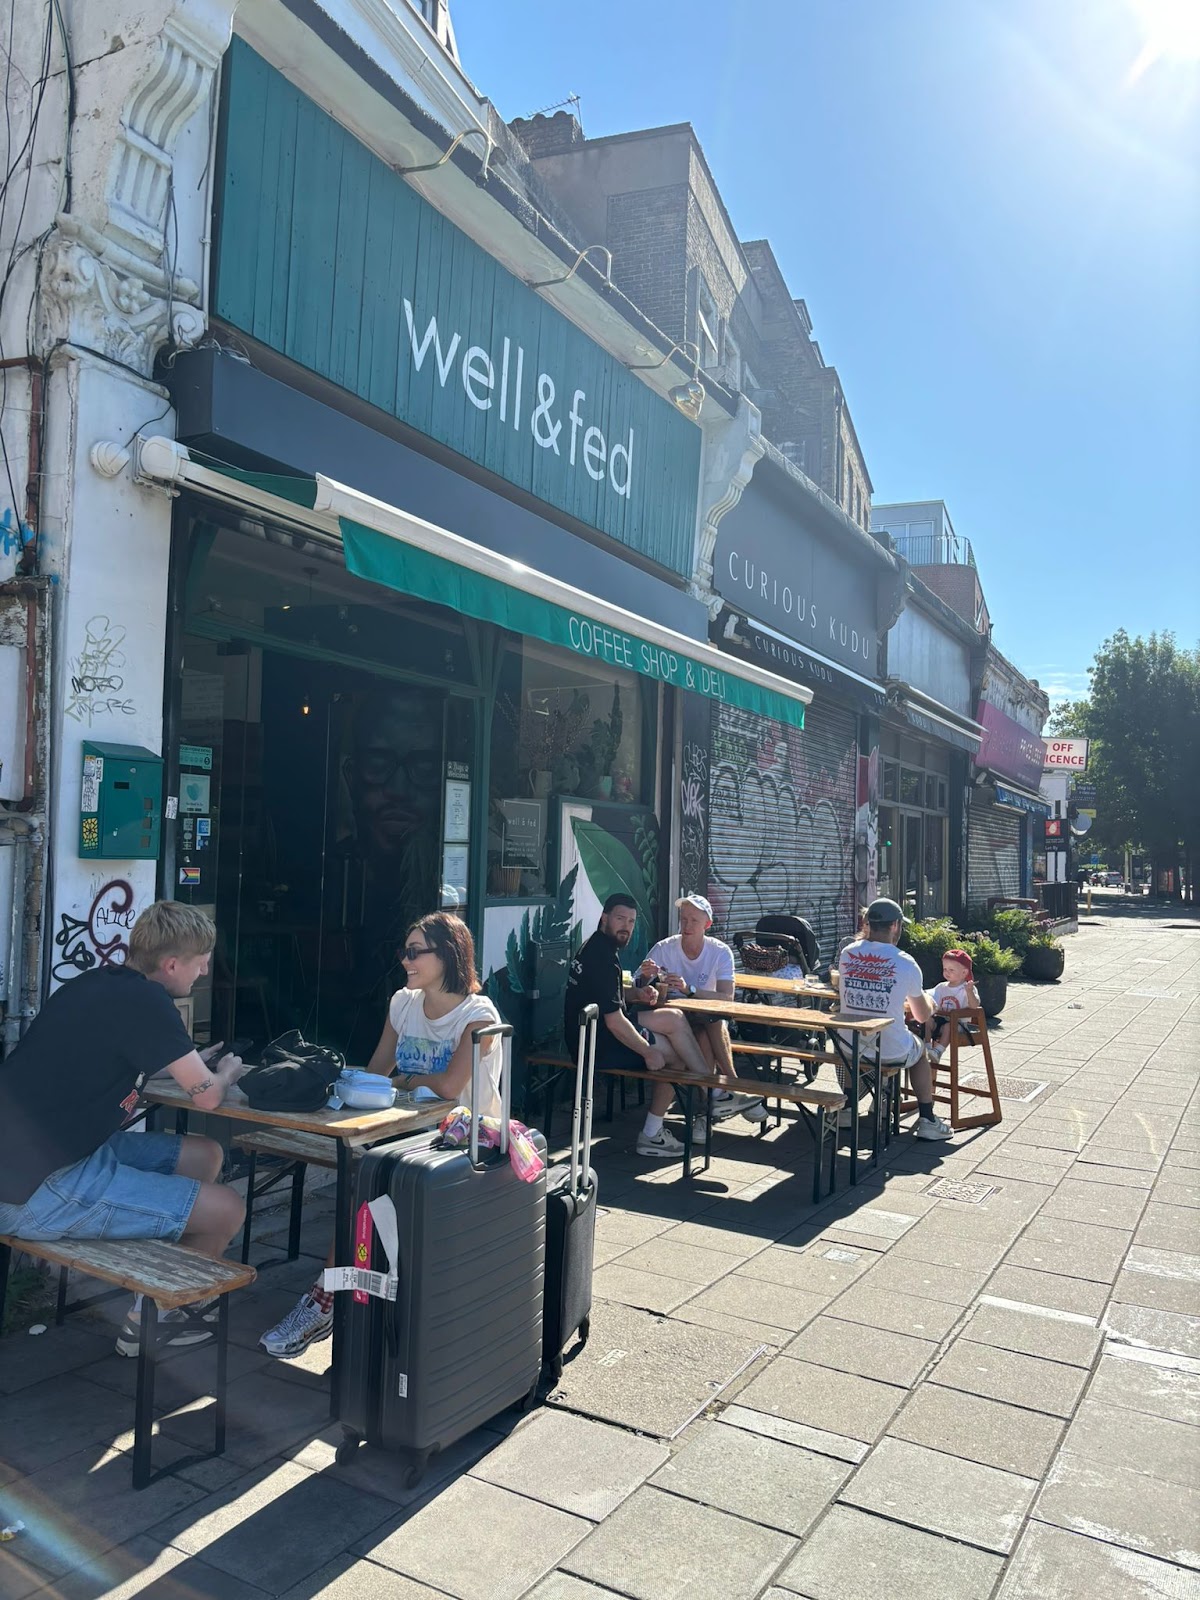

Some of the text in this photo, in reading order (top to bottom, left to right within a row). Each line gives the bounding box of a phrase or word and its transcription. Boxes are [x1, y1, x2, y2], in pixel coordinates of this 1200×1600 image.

[729, 552, 869, 660] CURIOUS KUDU
[569, 617, 726, 699] COFFEE SHOP & DELI
[755, 635, 833, 683] CURIOUS KUDU
[1045, 754, 1085, 765] ICENCE
[1052, 742, 1074, 752] OFF
[855, 966, 891, 976] STONES
